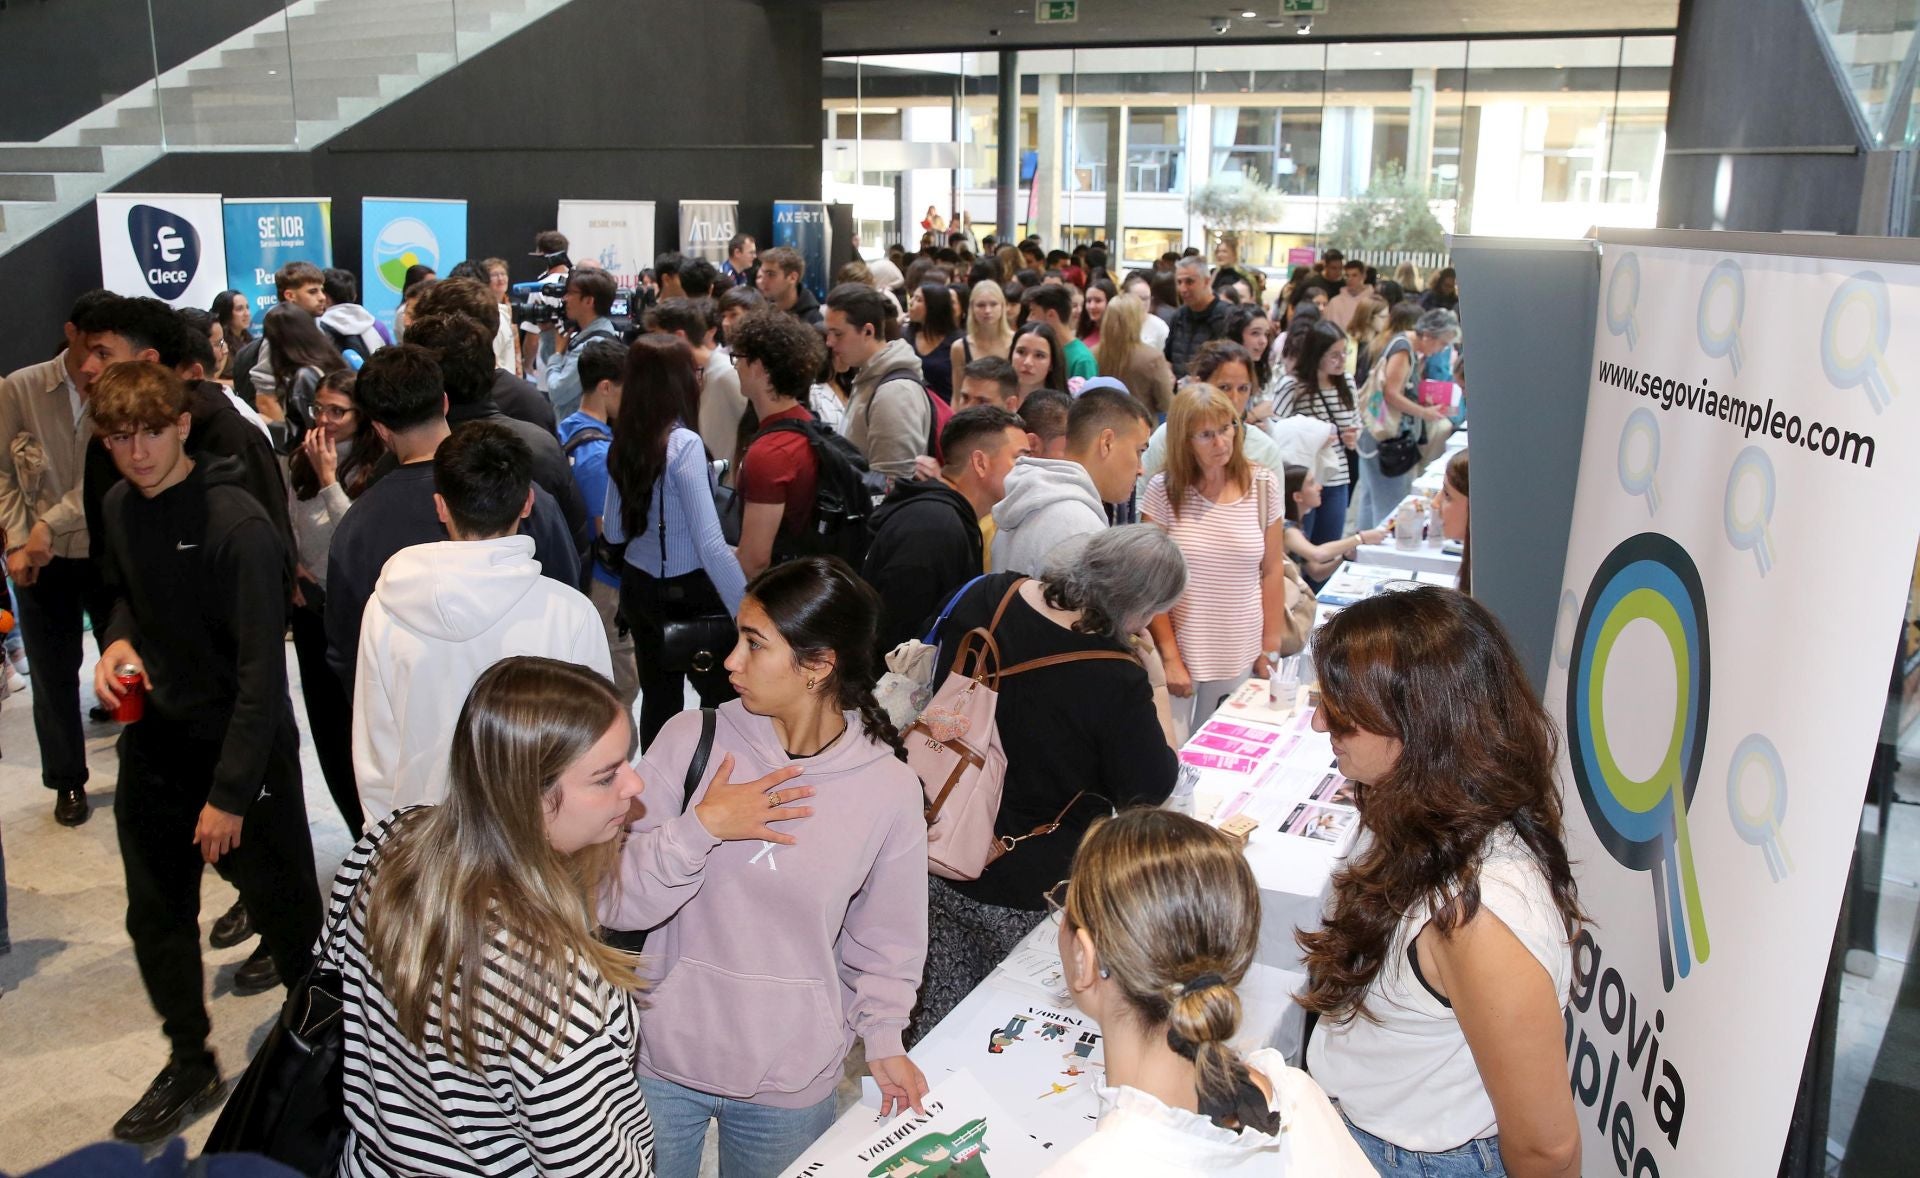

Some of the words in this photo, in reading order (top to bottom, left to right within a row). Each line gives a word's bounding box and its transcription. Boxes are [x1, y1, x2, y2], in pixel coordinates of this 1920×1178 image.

[688, 216, 735, 241] ATLAS
[148, 268, 187, 284] Clece
[256, 295, 277, 309] que
[1599, 360, 1876, 468] www.segoviaempleo.com
